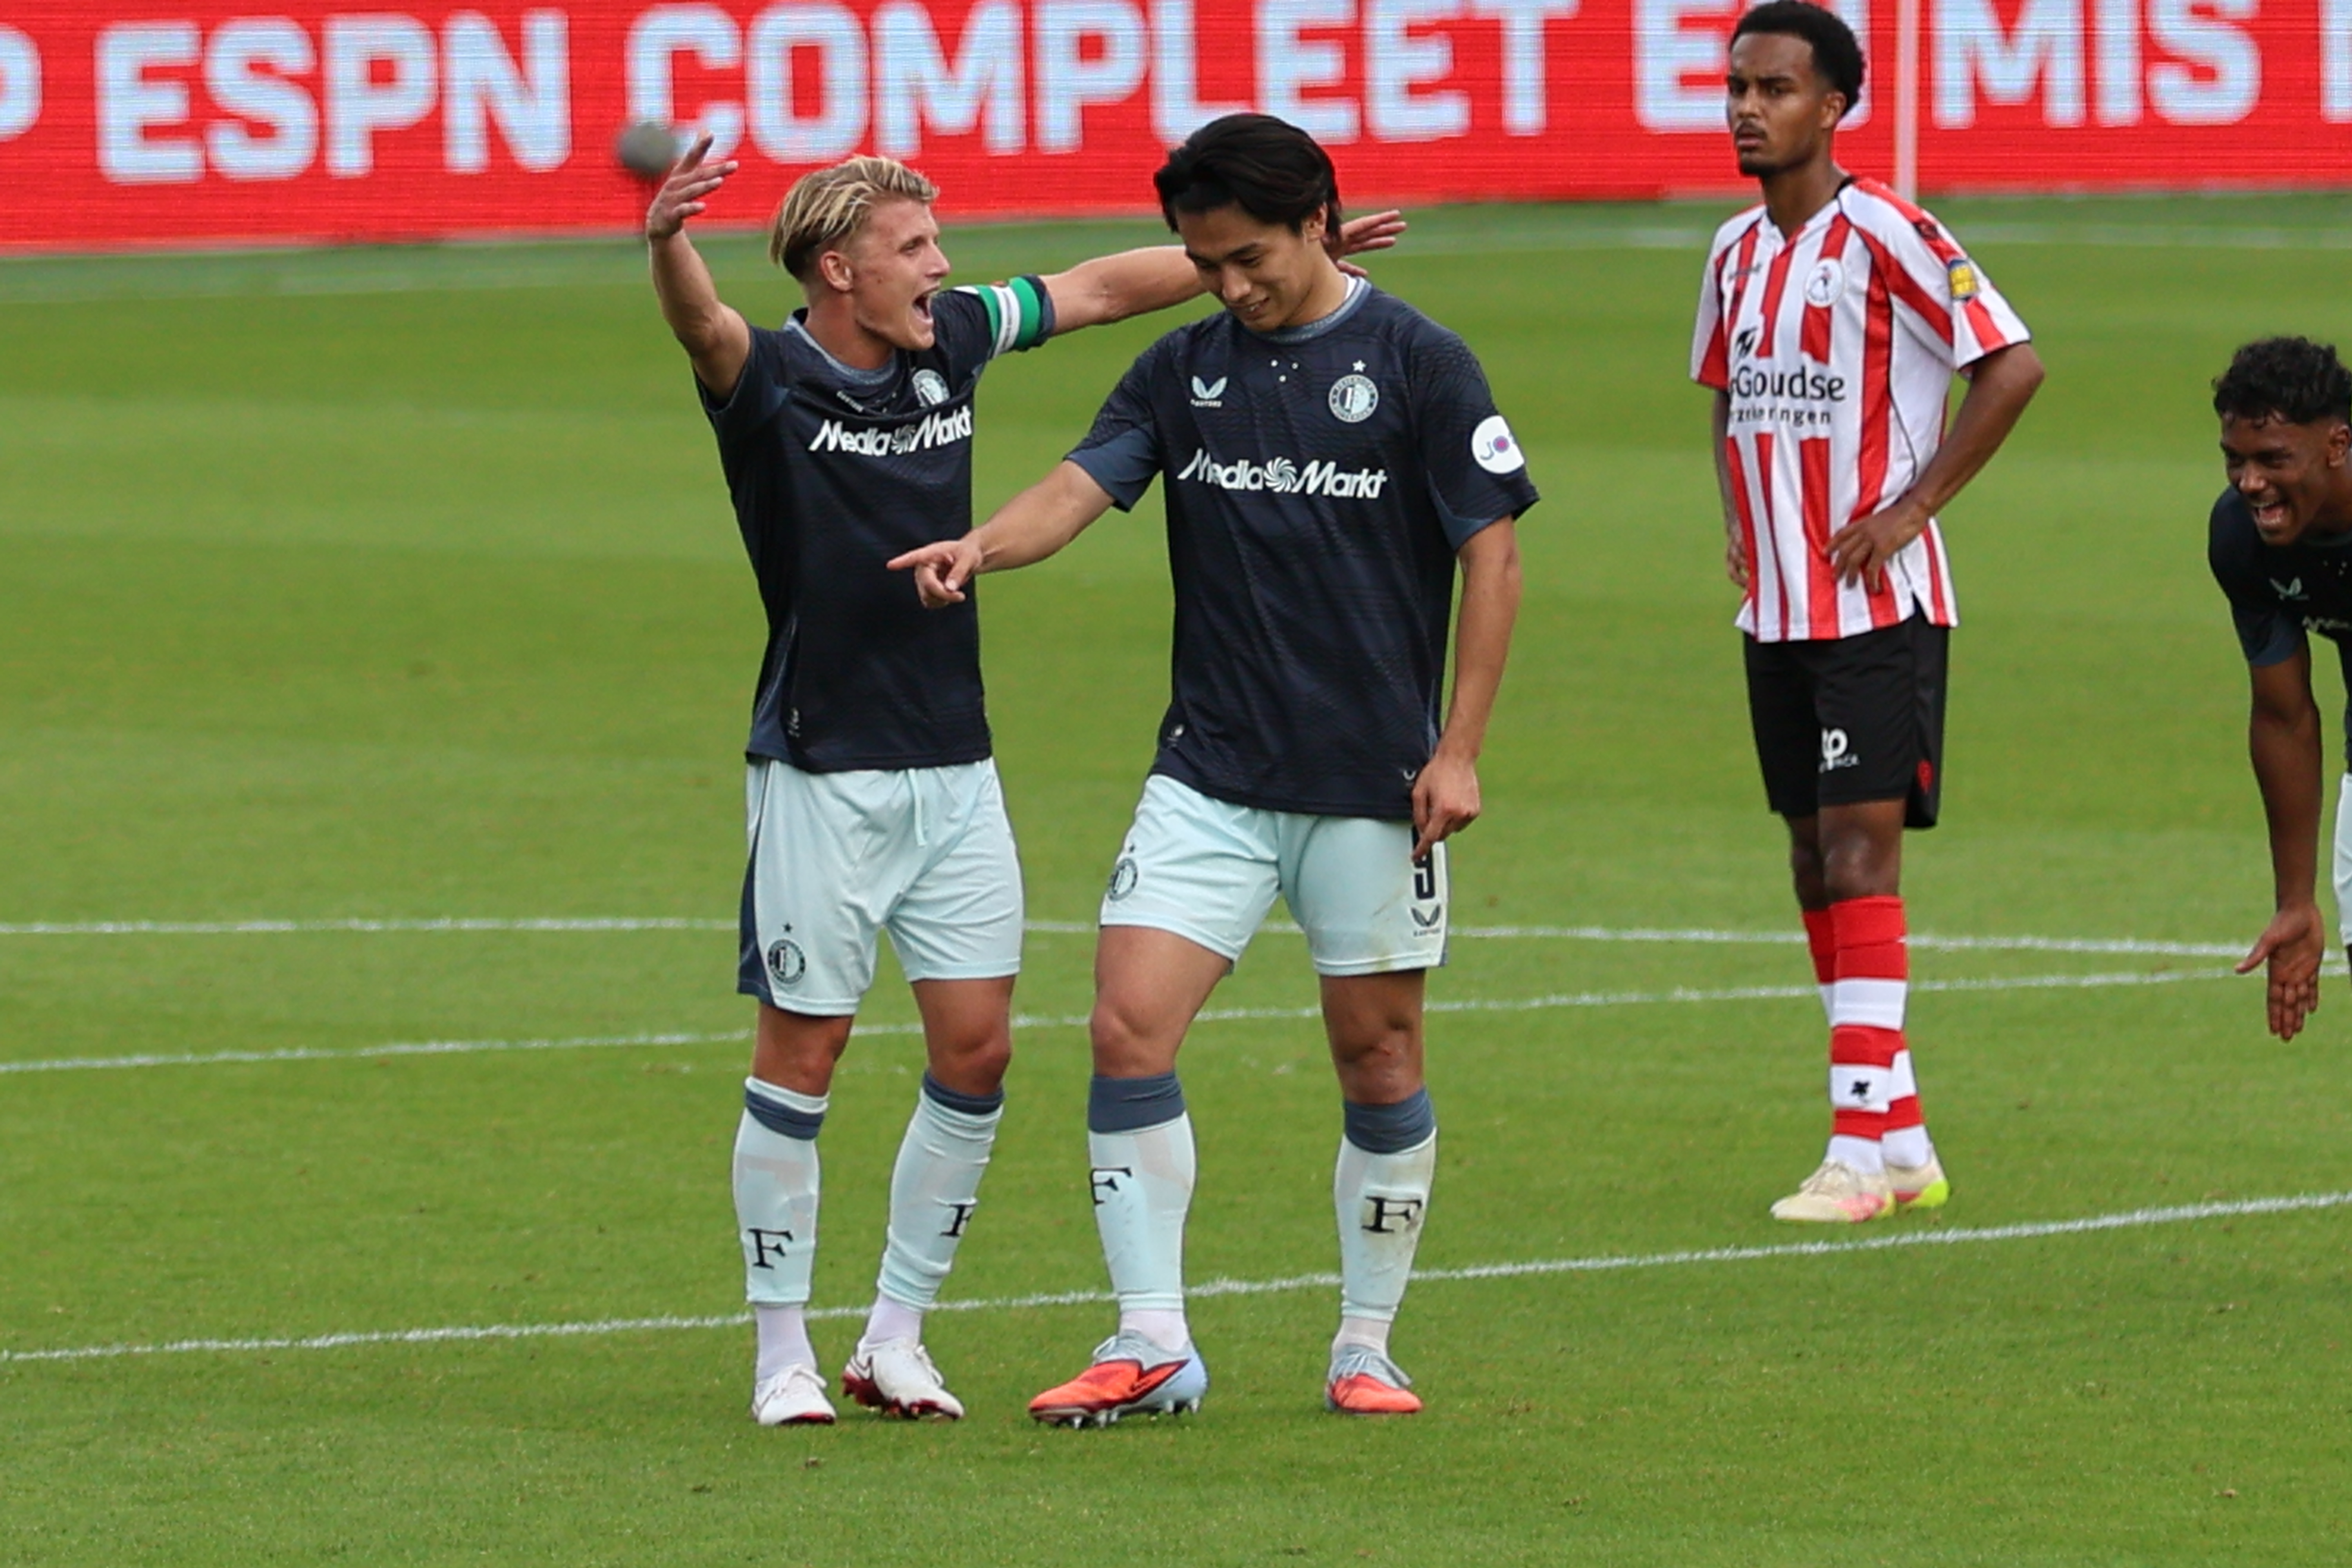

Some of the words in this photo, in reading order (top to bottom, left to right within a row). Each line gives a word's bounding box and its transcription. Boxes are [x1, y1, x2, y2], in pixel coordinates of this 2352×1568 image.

[94, 8, 572, 184] ESPN
[626, 0, 1581, 164] COMPLEET
[1631, 0, 1872, 134] E
[1931, 0, 2263, 129] MIS
[808, 419, 892, 456] Media
[909, 405, 972, 452] Markt
[1177, 448, 1263, 490] Media
[1290, 459, 1387, 499] Markt
[1090, 1167, 1132, 1206] F
[1361, 1196, 1422, 1234] F
[748, 1228, 793, 1270] F
